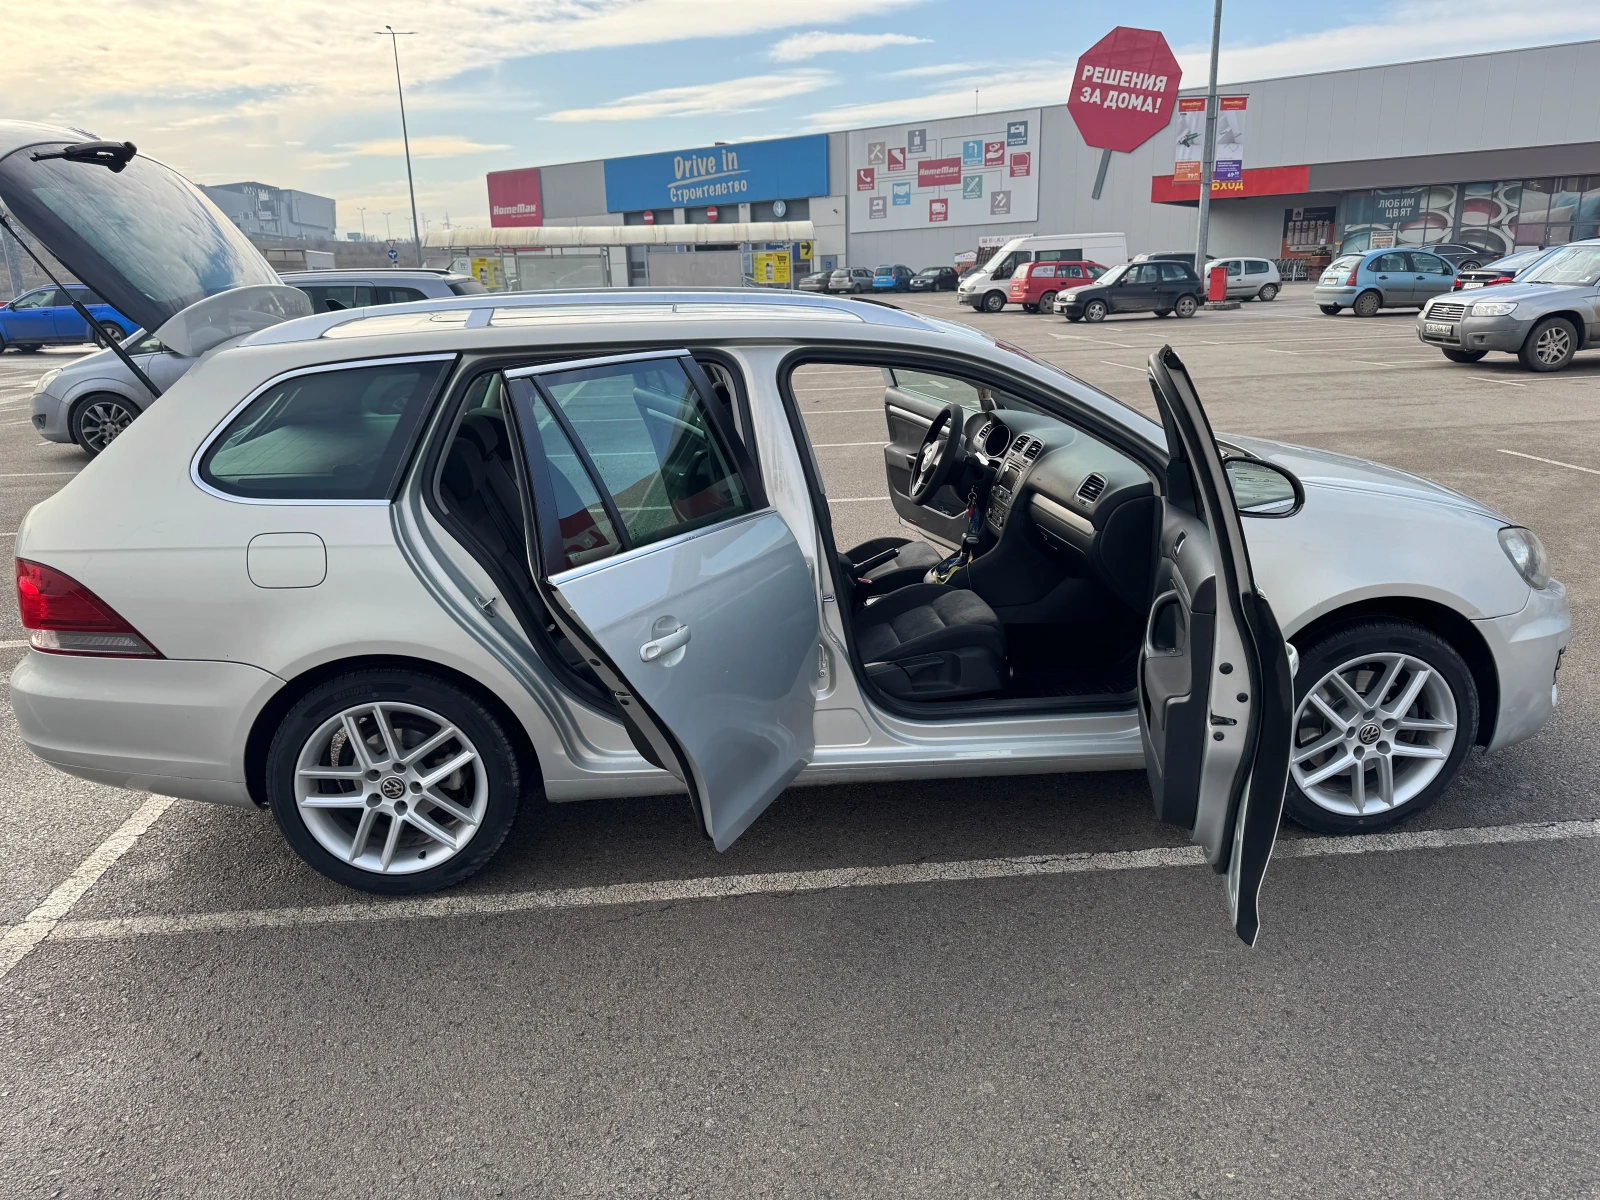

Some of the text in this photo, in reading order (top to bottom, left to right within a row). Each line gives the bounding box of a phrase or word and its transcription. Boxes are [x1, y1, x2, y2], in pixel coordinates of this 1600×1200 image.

[1082, 65, 1167, 92] РЕШЕНИЯ
[1080, 86, 1162, 113] ЗА ДОМА!
[674, 149, 738, 180] Drive in
[670, 179, 748, 204] Строителство
[1378, 197, 1415, 208] ЛЮБИМ
[1385, 208, 1412, 219] ЦВЯТ
